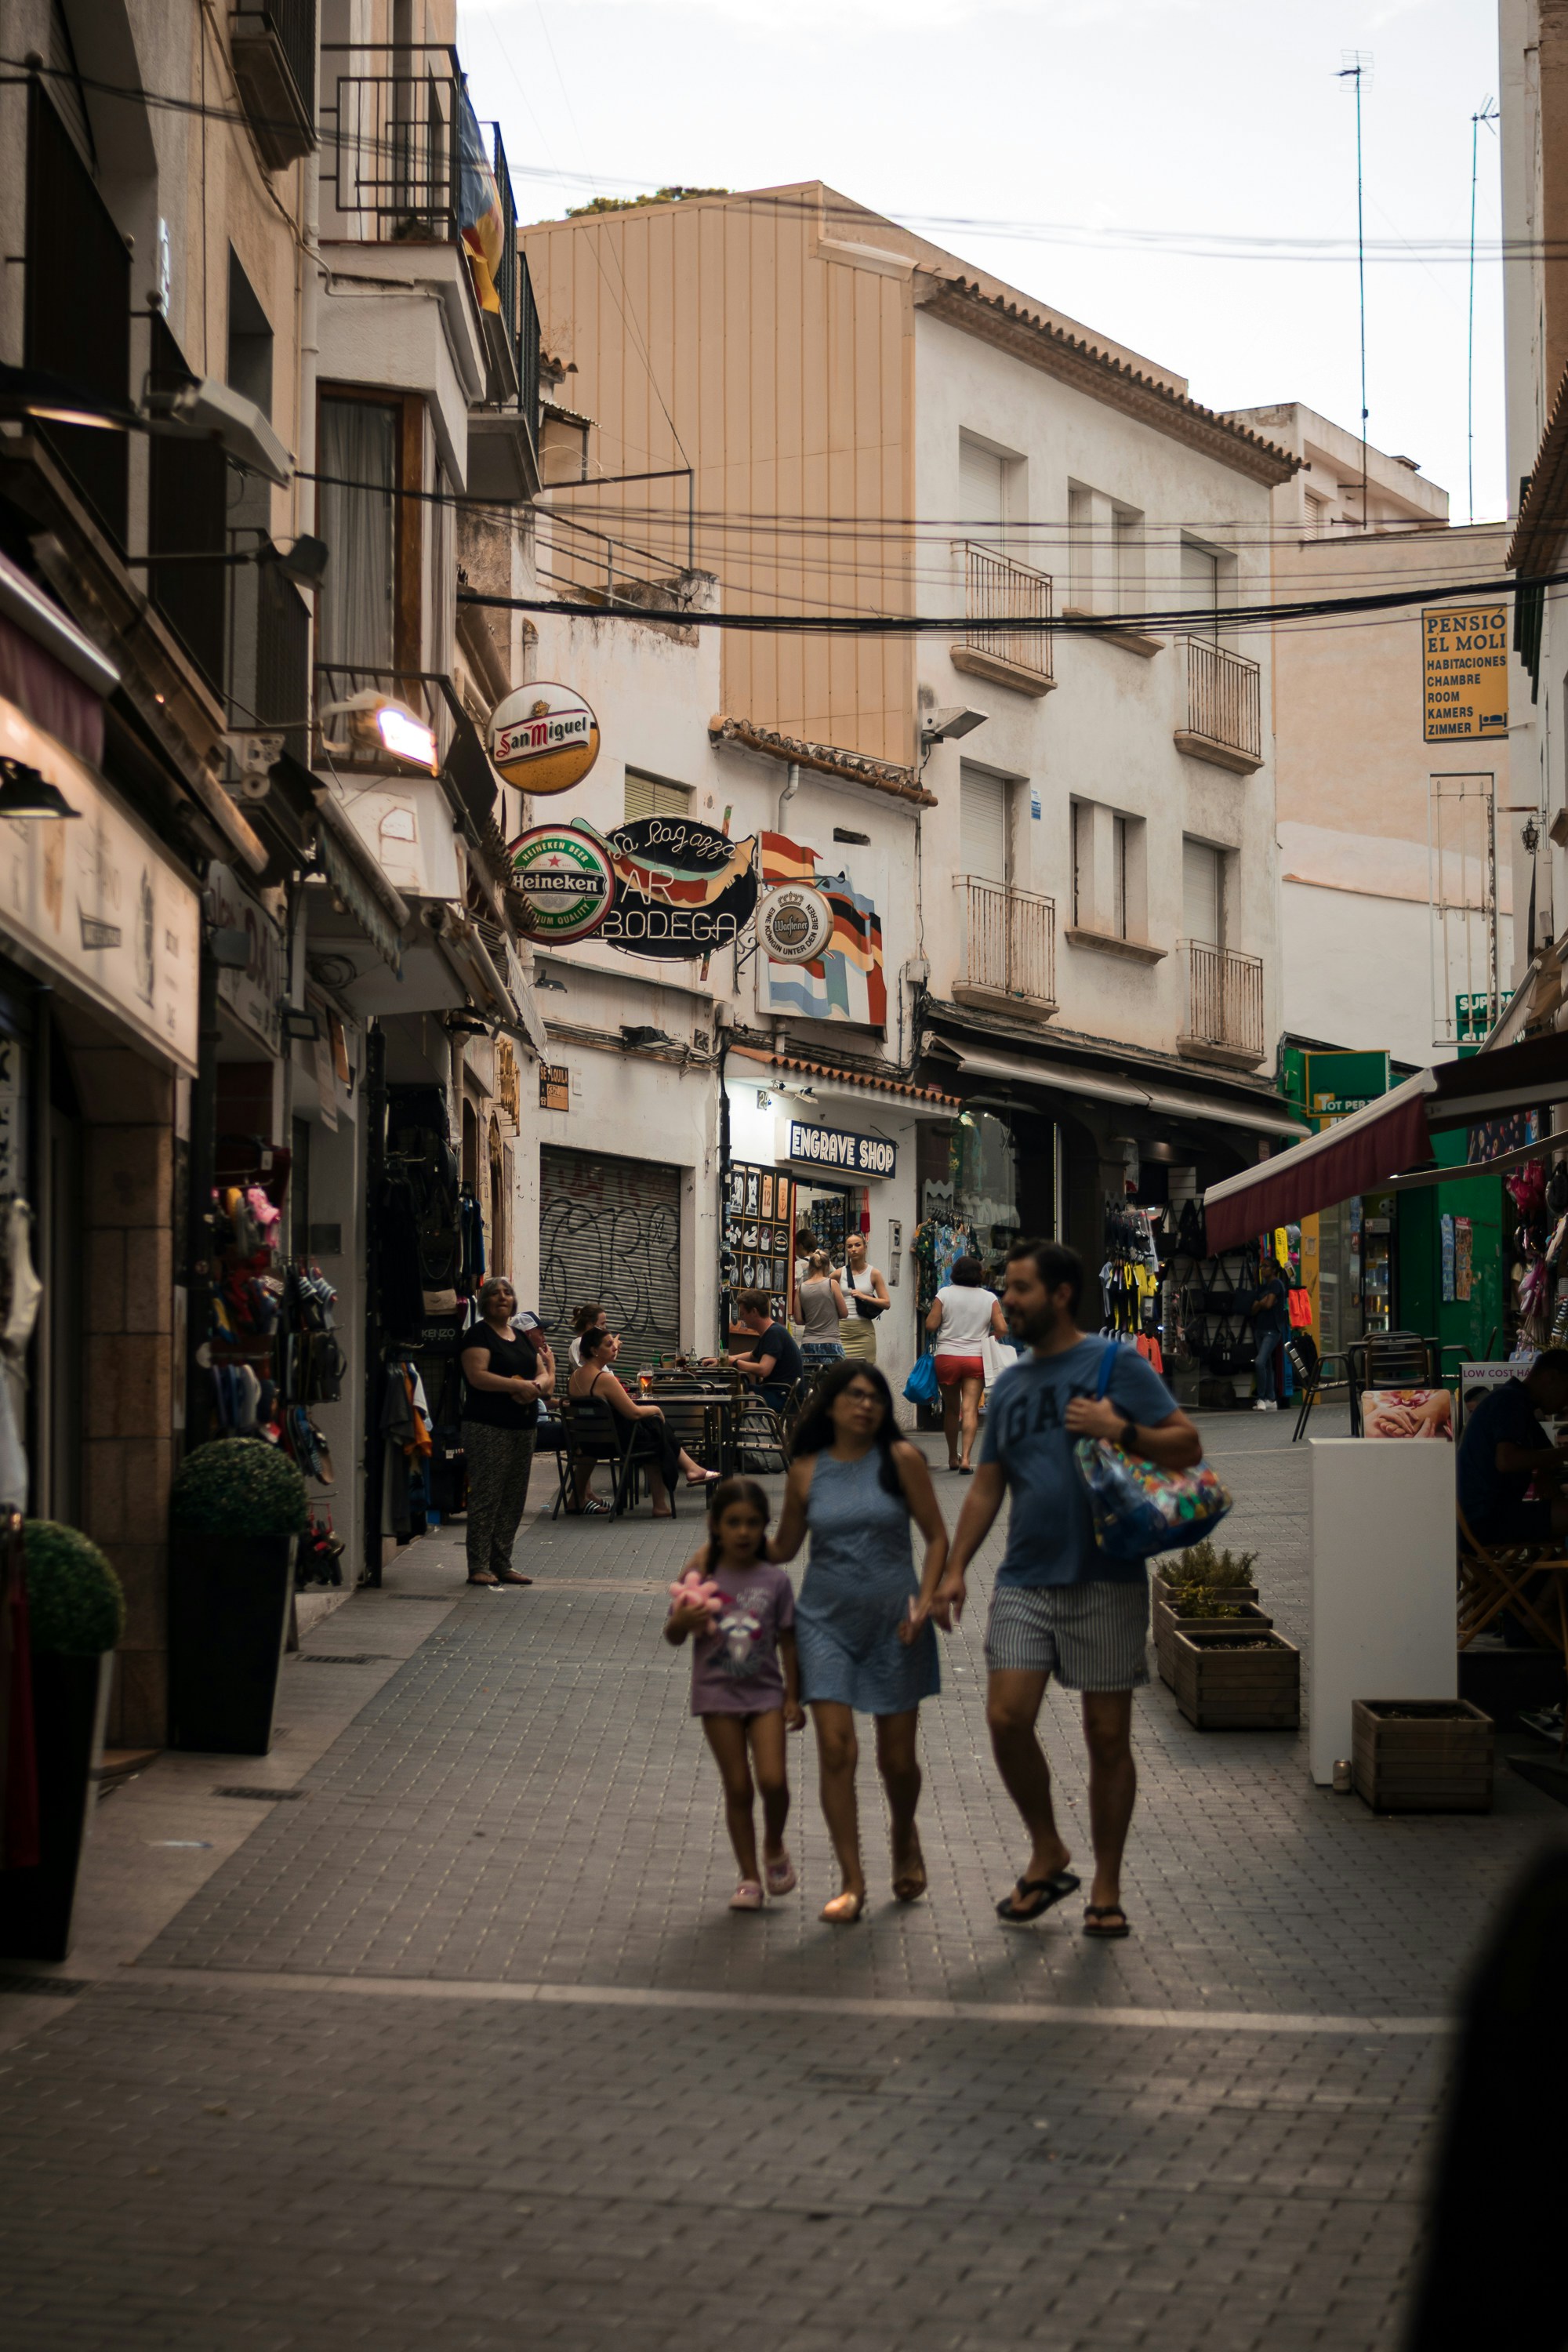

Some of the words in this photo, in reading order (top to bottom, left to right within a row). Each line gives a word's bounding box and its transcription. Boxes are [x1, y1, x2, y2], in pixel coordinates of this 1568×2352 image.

[1427, 608, 1506, 633] PENSIÓ
[1427, 637, 1450, 653] EL
[1455, 633, 1506, 651] MOLI
[1427, 655, 1506, 671] HABITACIONES
[1427, 673, 1481, 687] CHAMBRE
[1427, 691, 1460, 702] ROOM
[1428, 706, 1473, 719] KAMERS
[1428, 722, 1472, 735] ZIMMER
[521, 841, 566, 862] HEINEKEN
[568, 844, 589, 863] BEER
[613, 833, 639, 860] La
[513, 873, 598, 892] Heineken
[620, 869, 674, 906] AR
[557, 902, 590, 925] QUALITY
[765, 906, 776, 924] EINE
[805, 903, 818, 931] BIEREN
[601, 910, 737, 941] BODEGA
[765, 925, 782, 953] KÖNIGIN
[805, 931, 818, 948] DEN
[783, 945, 807, 956] UNTER
[539, 1065, 547, 1080] SE
[1317, 1095, 1343, 1111] TOT
[792, 1125, 855, 1166] ENGRAVE
[859, 1139, 894, 1173] SHOP
[422, 1328, 456, 1338] KENZO
[1463, 1370, 1485, 1378] LOW
[1488, 1369, 1514, 1378] COST
